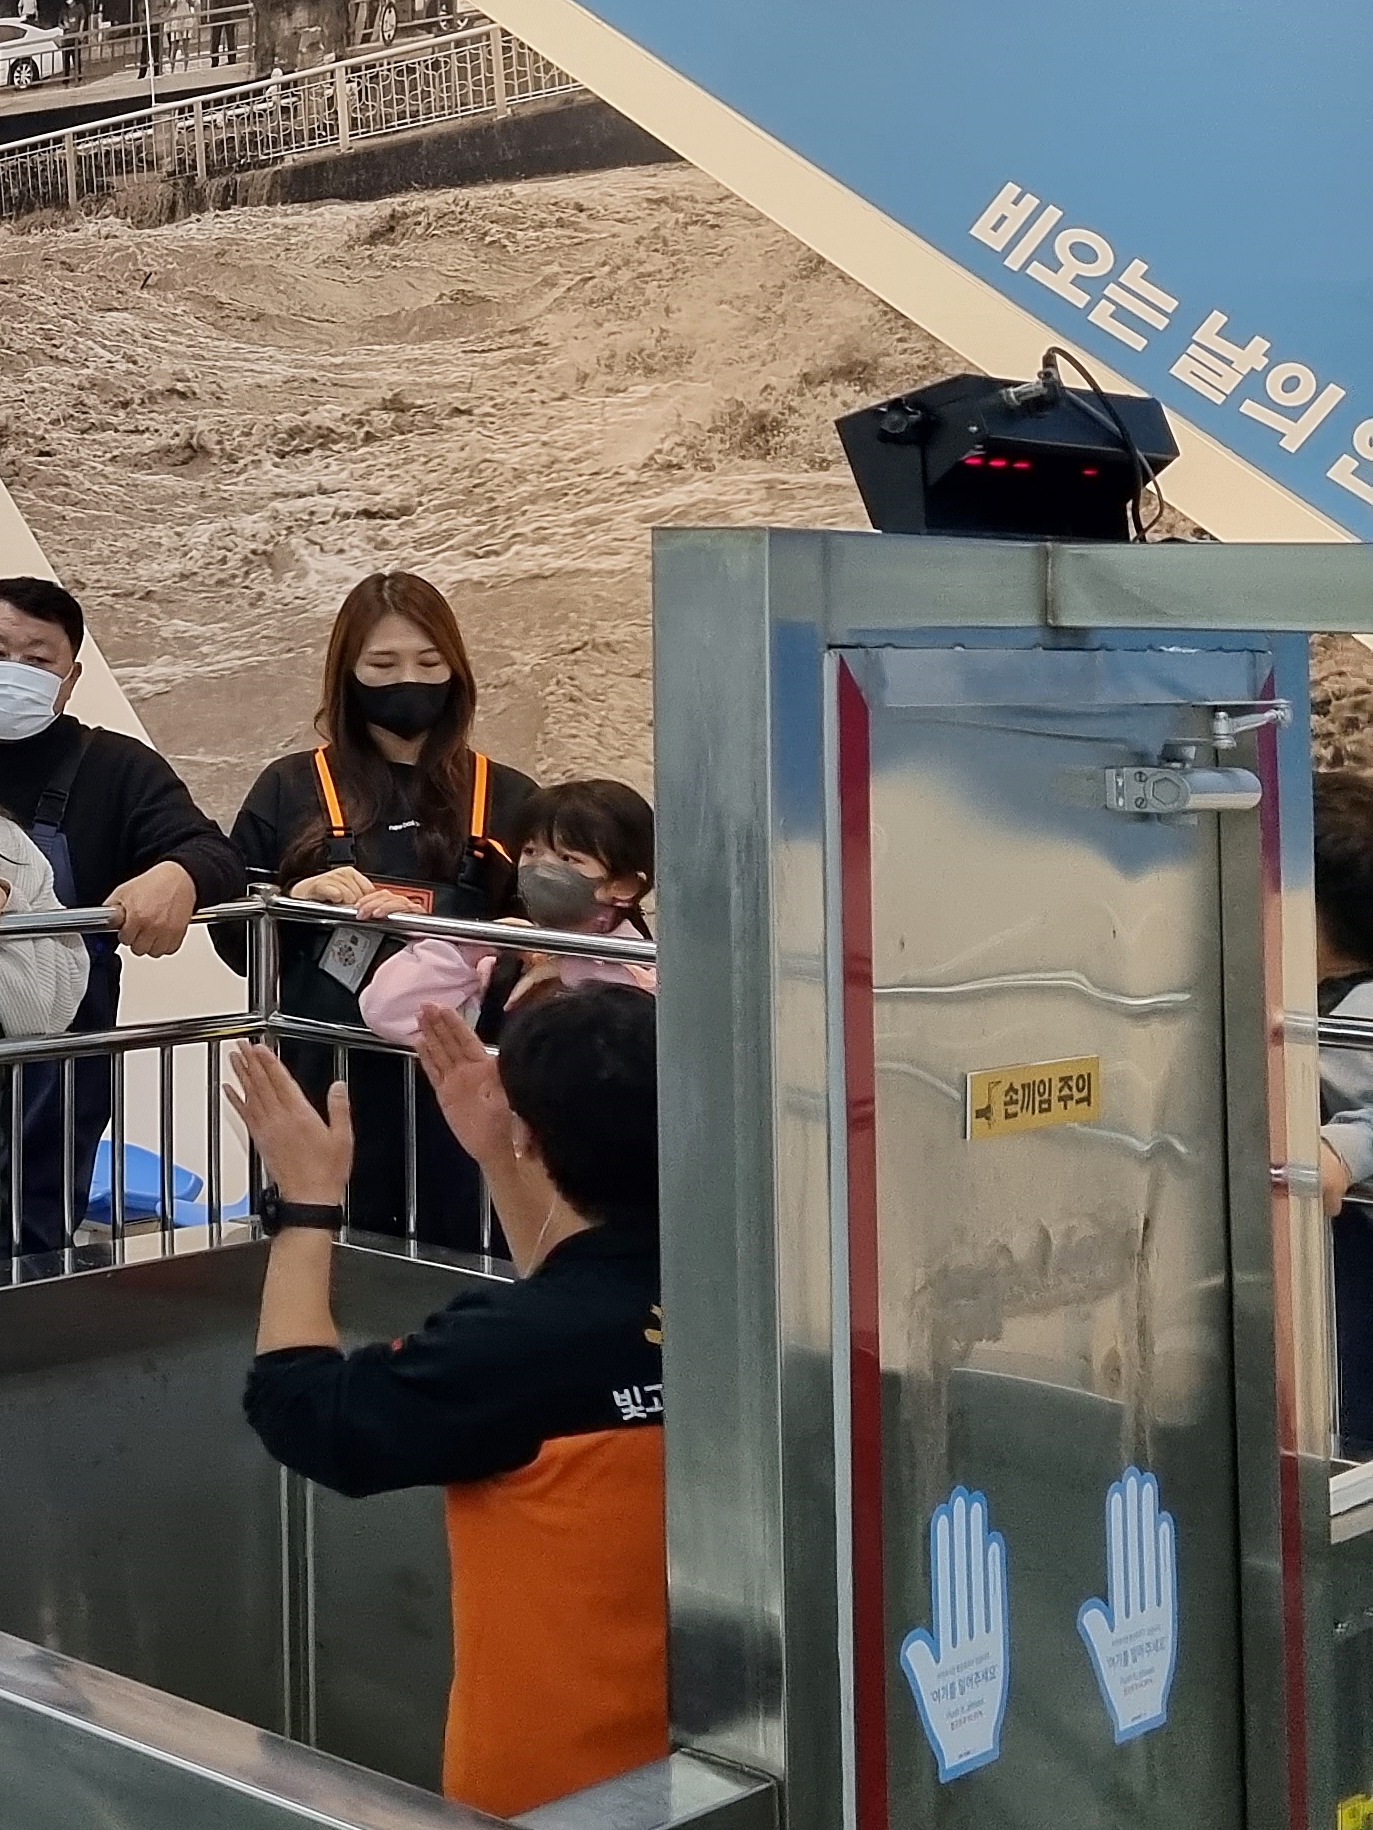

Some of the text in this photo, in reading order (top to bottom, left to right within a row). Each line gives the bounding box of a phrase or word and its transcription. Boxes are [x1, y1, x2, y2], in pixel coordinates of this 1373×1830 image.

[969, 180, 1347, 454] 비오는 날의
[1003, 1072, 1092, 1121] 손끼임 주의
